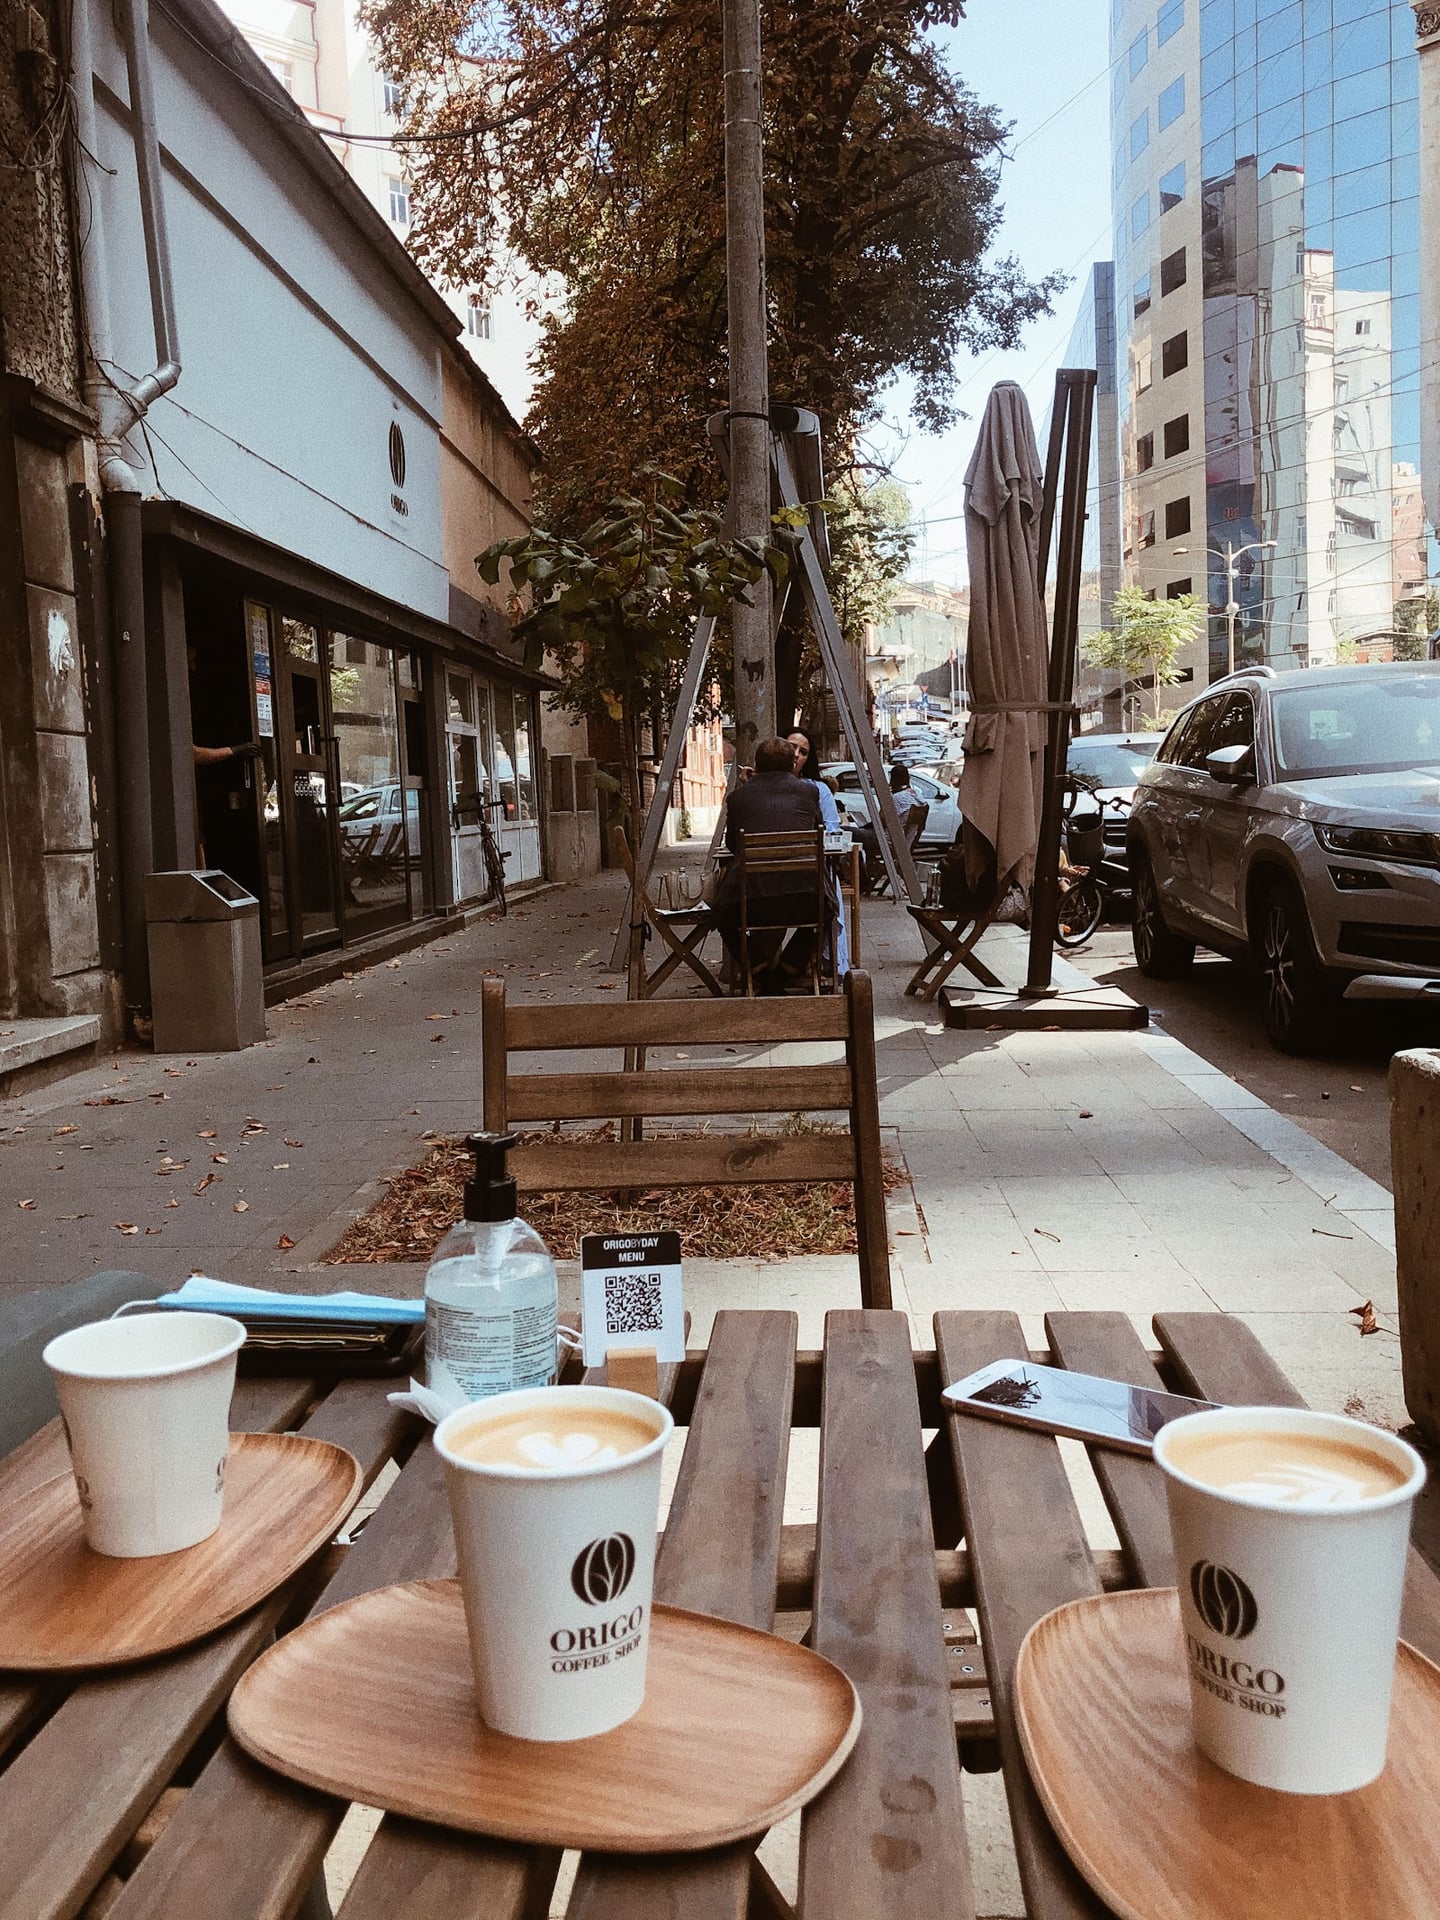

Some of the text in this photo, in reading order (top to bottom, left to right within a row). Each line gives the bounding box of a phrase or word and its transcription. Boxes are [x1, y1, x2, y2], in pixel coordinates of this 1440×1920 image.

[618, 1251, 646, 1263] MENU
[550, 1605, 643, 1653] ORIGO
[551, 1634, 642, 1673] COFFEE SHOP
[1239, 1694, 1286, 1719] SHOP
